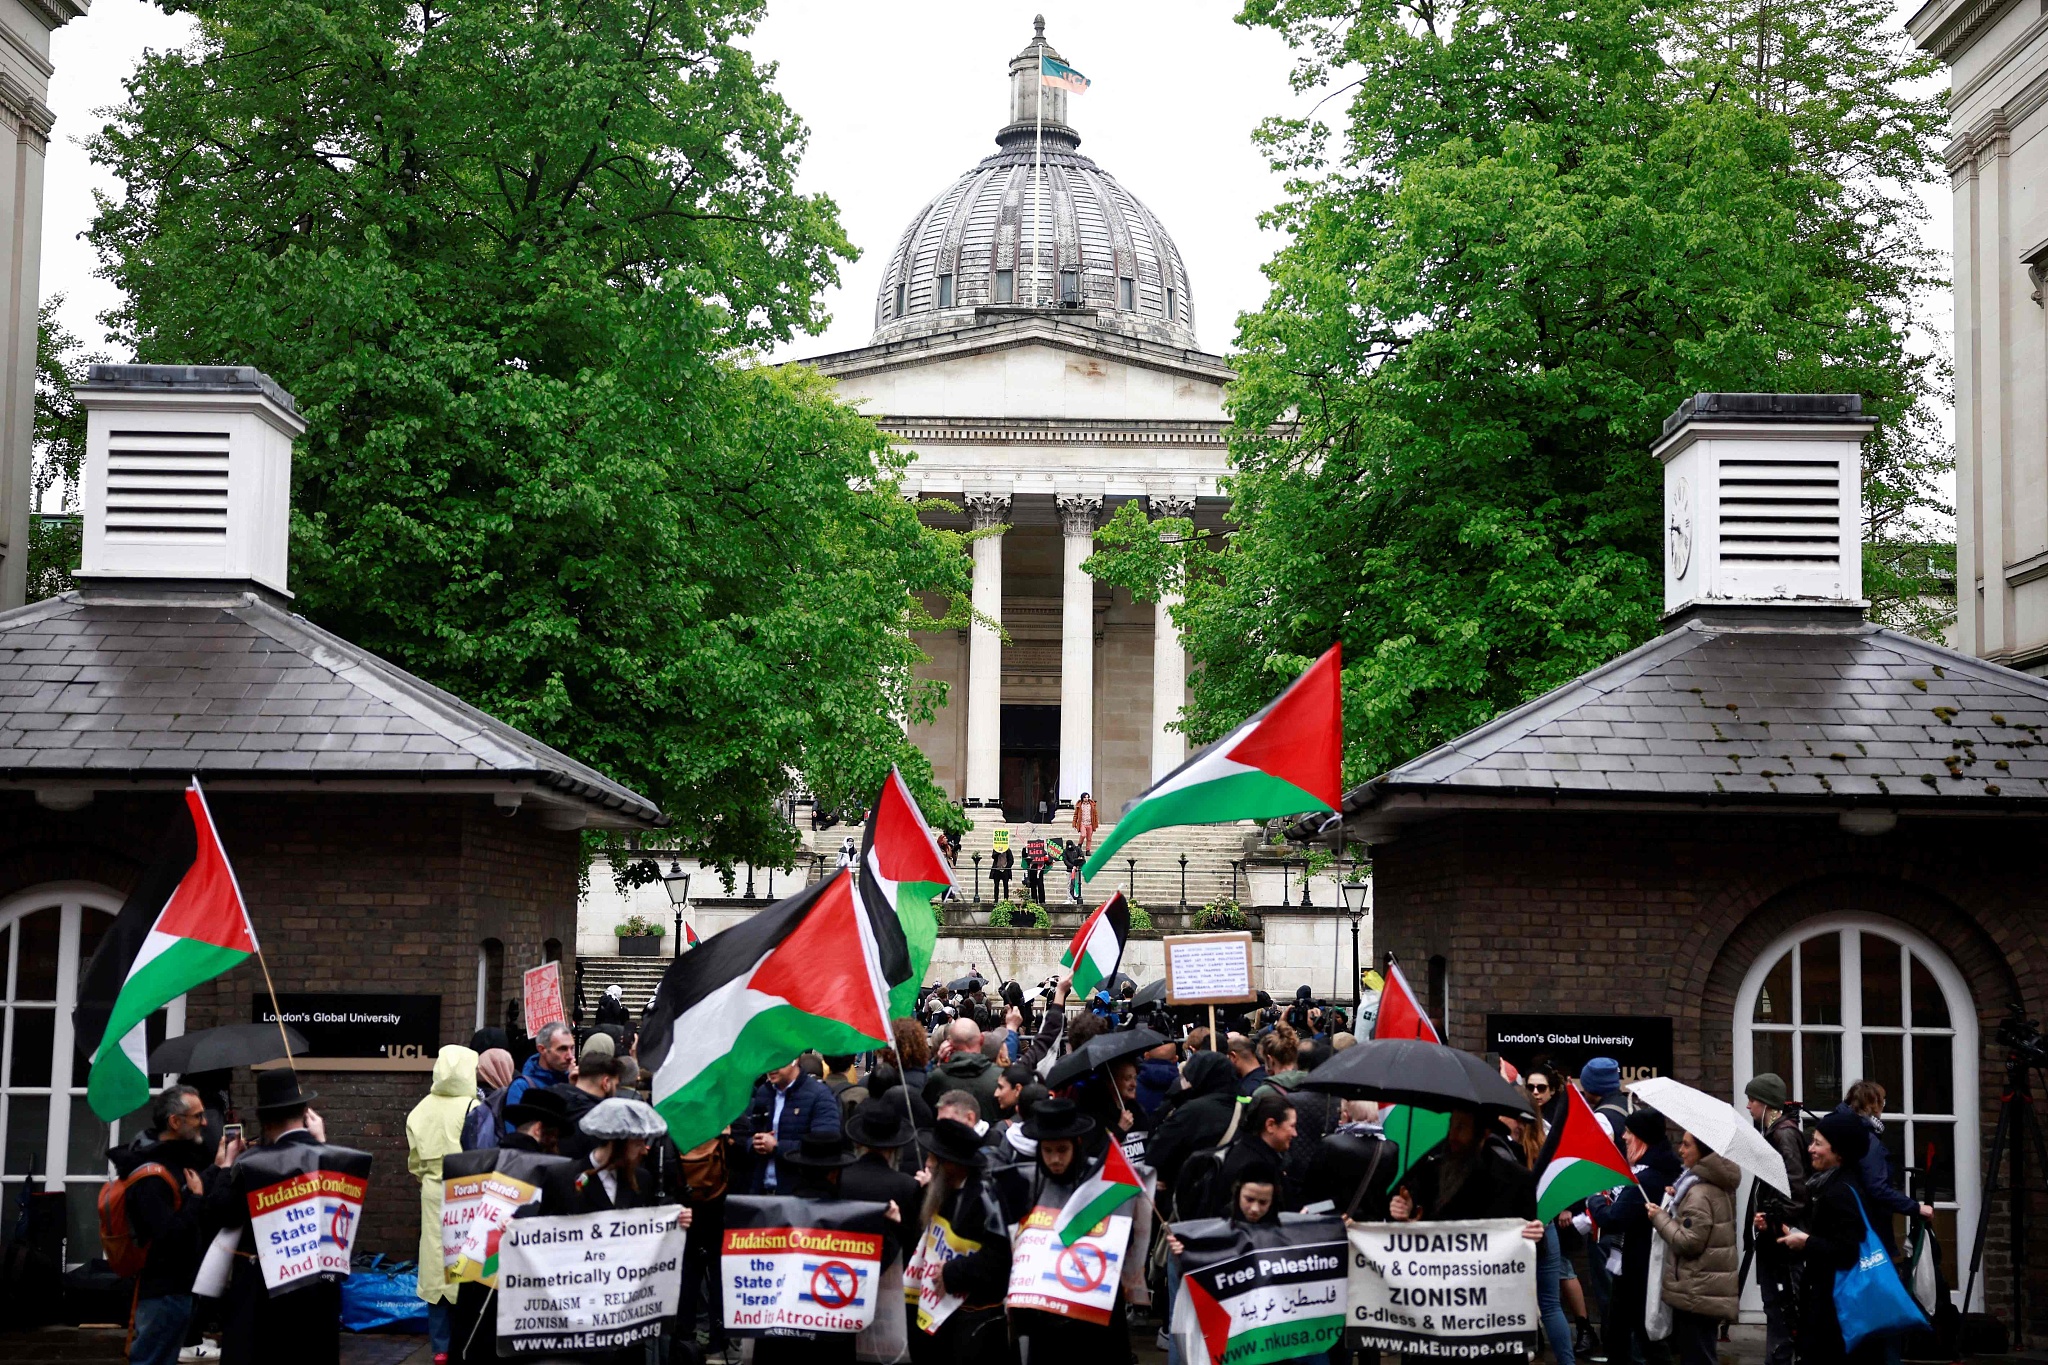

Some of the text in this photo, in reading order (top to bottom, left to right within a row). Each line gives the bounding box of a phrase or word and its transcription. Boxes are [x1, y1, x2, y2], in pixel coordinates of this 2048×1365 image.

[263, 1012, 401, 1025] London's Global University
[1498, 1033, 1634, 1047] London's Global University
[387, 1044, 428, 1059] UCL
[256, 1174, 362, 1210] Judaism ondemns
[454, 1183, 478, 1197] Torah
[286, 1205, 315, 1222] the
[443, 1210, 459, 1227] ALL
[270, 1222, 317, 1245] State
[509, 1218, 678, 1247] Judaism & Zionism
[728, 1230, 875, 1255] Judaism Condemns
[1383, 1233, 1488, 1252] JUDAISM
[584, 1250, 606, 1262] Are
[750, 1258, 774, 1271] the
[279, 1255, 314, 1280] And
[506, 1258, 676, 1289] Diametrically Opposed
[1215, 1255, 1339, 1290] Free Palestine
[1392, 1261, 1401, 1276] &
[1408, 1259, 1526, 1280] Compassionate
[734, 1274, 786, 1289] State of
[524, 1296, 581, 1312] JUDAISM
[1240, 1285, 1336, 1321] فلسطين عربية
[1388, 1287, 1487, 1307] ZIONISM
[514, 1317, 568, 1331] ZIONISM
[592, 1301, 663, 1327] NATIONALISM
[734, 1310, 761, 1324] And
[776, 1308, 864, 1330] Atrocities
[1355, 1306, 1526, 1330] G-dless & Merciless
[512, 1322, 661, 1351] www.nkEurope.org
[1361, 1336, 1524, 1358] www.nkEurope.org
